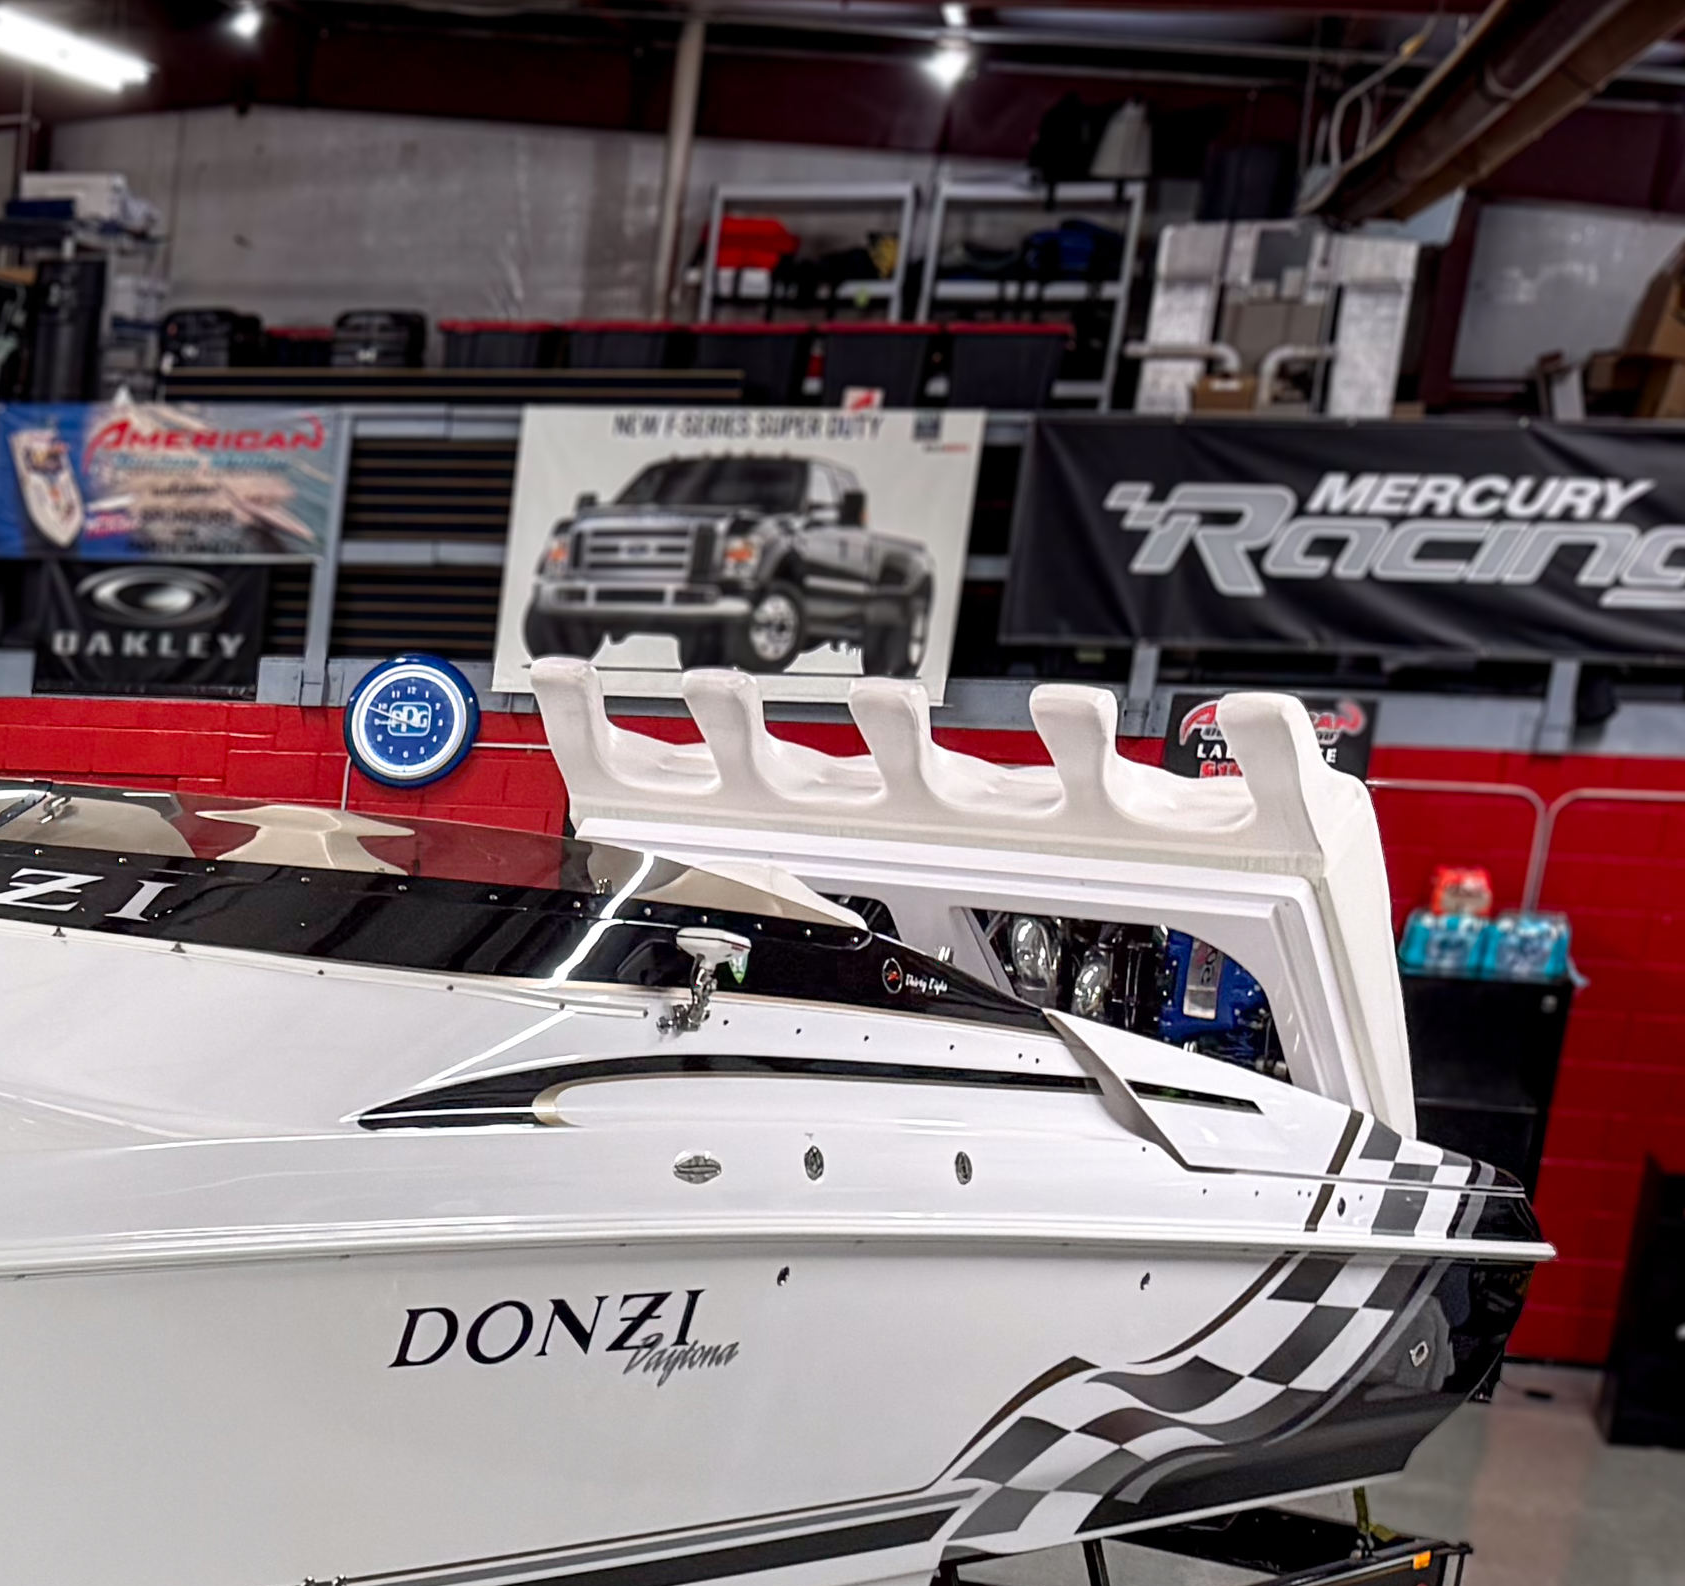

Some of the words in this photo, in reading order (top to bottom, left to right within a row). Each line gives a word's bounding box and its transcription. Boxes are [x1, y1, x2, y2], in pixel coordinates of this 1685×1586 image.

[612, 411, 659, 438] NEW
[663, 412, 751, 439] F-SERIES
[754, 413, 825, 440] SUPER
[828, 414, 883, 442] DUTY
[1305, 471, 1656, 520] MERCURY
[51, 630, 245, 659] OAKLEY
[386, 1288, 708, 1369] DONZI
[622, 1332, 740, 1388] Daytona
